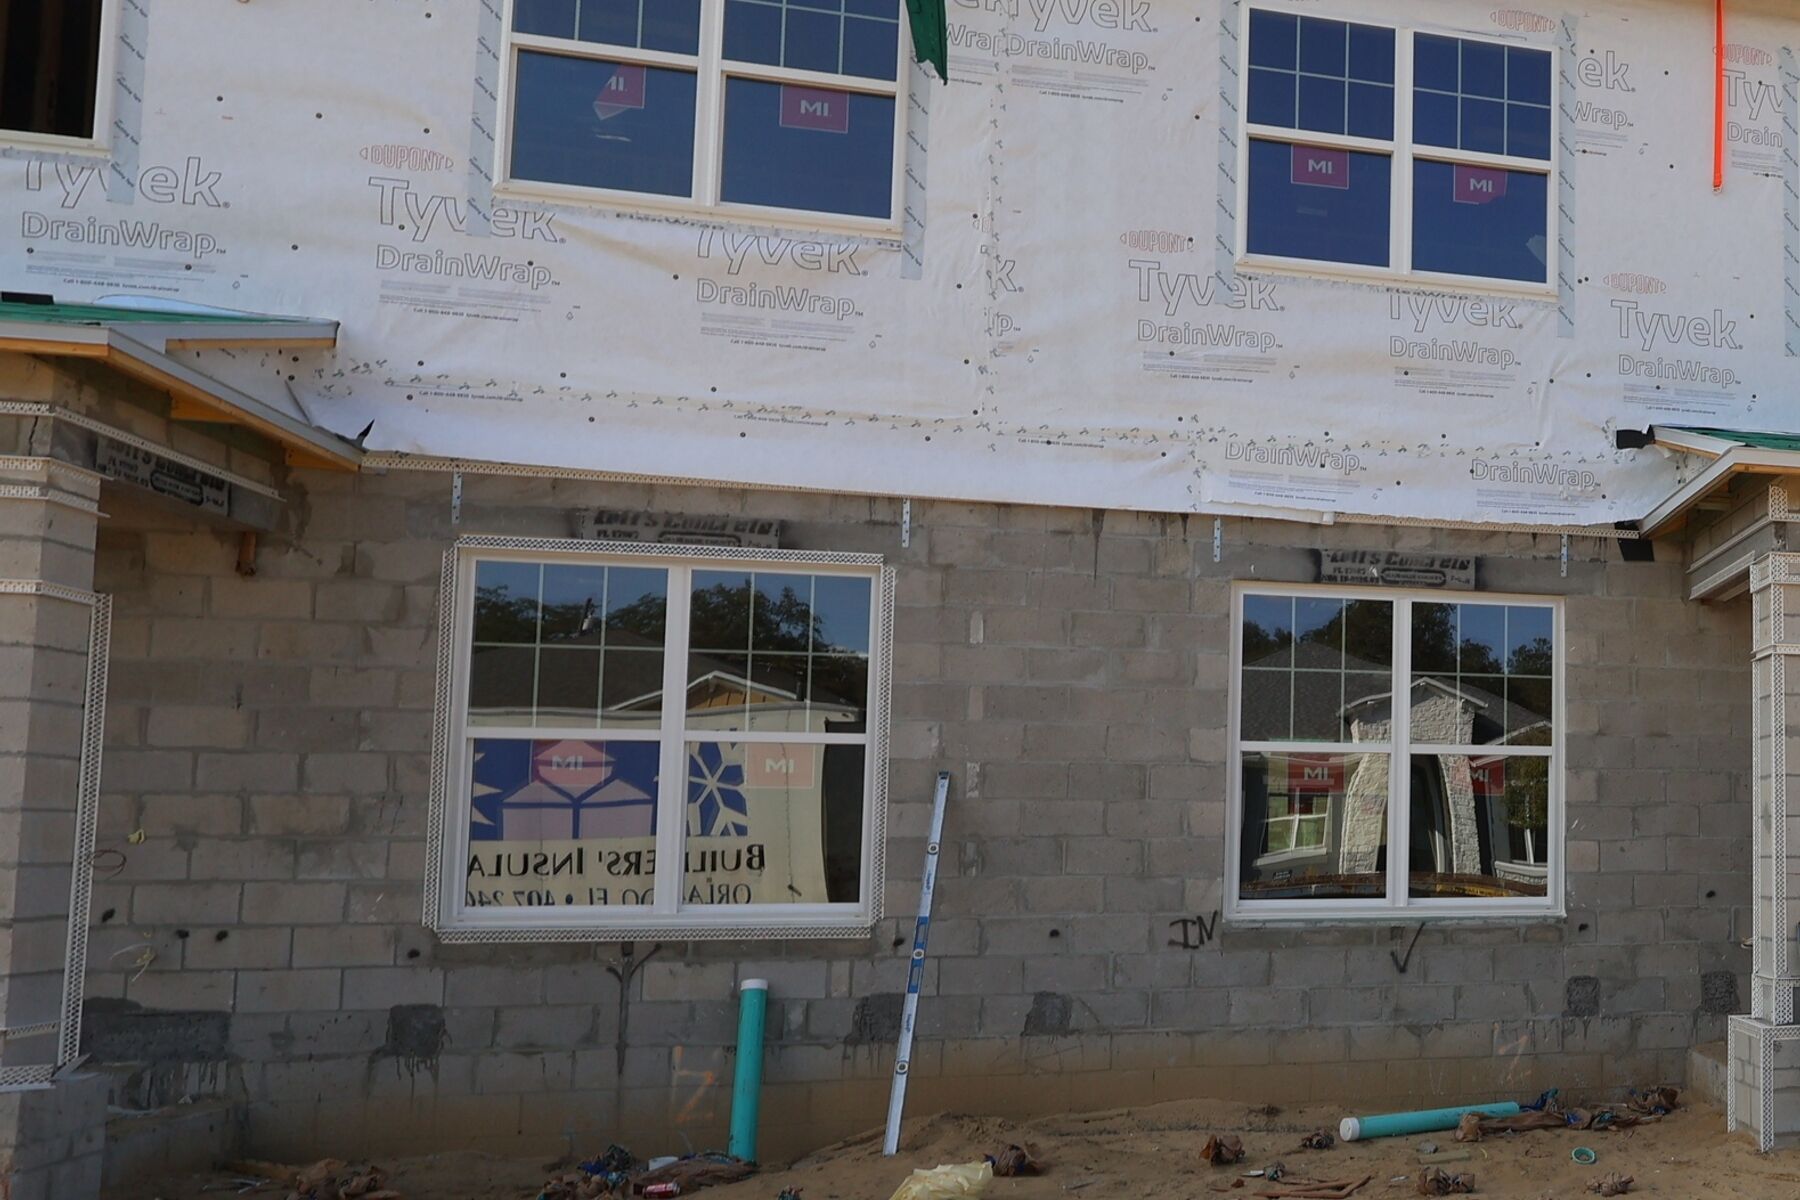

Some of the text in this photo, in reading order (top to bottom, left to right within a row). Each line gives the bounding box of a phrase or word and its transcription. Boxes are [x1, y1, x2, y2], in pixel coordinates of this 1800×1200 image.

[1009, 0, 1152, 32] yvek
[800, 100, 829, 116] MI
[371, 144, 445, 171] DUPONT
[1308, 159, 1332, 174] MI
[26, 157, 222, 208] yek
[1470, 178, 1493, 193] MI
[22, 211, 216, 258] DrainWrap
[1128, 231, 1186, 253] DUPONT
[376, 244, 551, 290] DrainWrap
[697, 278, 855, 320] DrainWrap
[1137, 319, 1276, 353] DrainWrap
[1611, 299, 1738, 351] Tyvek
[1390, 335, 1515, 370] DrainWrap
[1619, 354, 1735, 389] DrainWrap
[1471, 458, 1596, 490] DrainWrap
[552, 755, 583, 771] MI
[765, 758, 795, 773] MI
[1303, 767, 1329, 781] MI
[1168, 911, 1217, 950] IN
